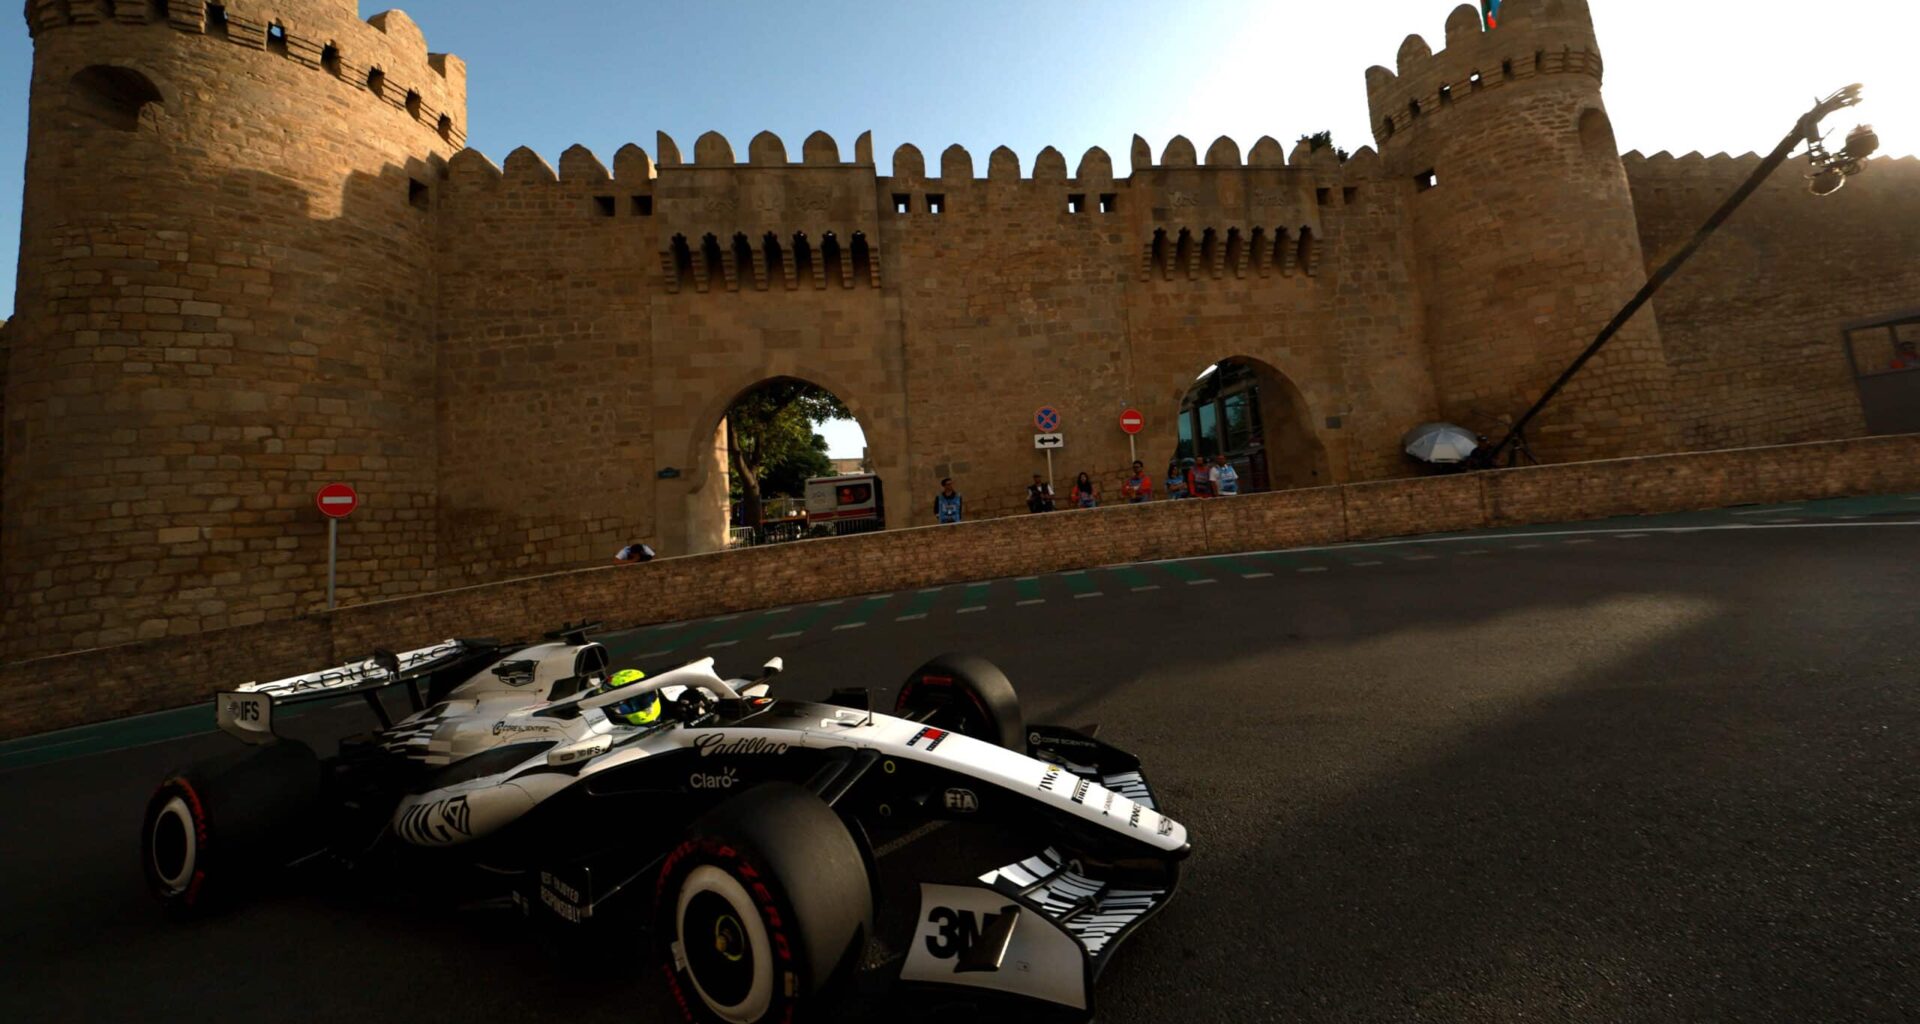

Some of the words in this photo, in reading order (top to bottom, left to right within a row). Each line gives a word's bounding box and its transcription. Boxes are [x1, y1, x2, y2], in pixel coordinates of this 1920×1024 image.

[257, 645, 461, 693] CADILAC
[240, 701, 259, 721] IFS
[586, 746, 600, 755] IFS
[694, 733, 790, 758] Cadillac
[689, 772, 733, 789] Claro
[944, 791, 977, 810] FIA
